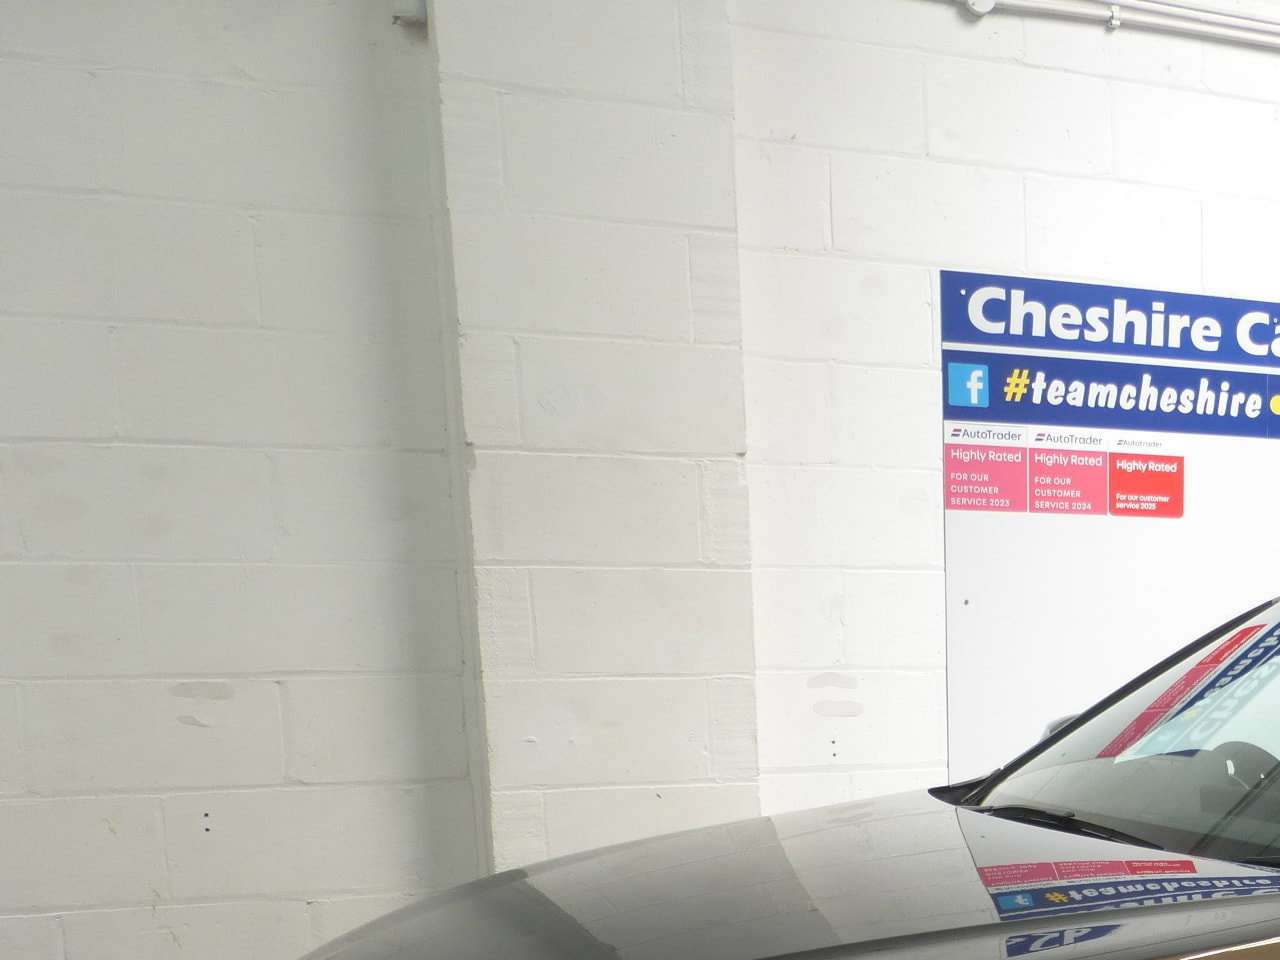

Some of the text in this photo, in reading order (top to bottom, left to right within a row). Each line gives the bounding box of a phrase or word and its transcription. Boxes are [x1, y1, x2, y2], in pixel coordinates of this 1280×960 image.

[968, 286, 1222, 353] Cheshire
[1003, 368, 1262, 419] #teamcheshire
[962, 428, 1022, 441] AutoTrader
[1046, 433, 1103, 446] AutoTrader
[951, 448, 1022, 463] Highly Rated
[1034, 453, 1103, 467] Highly Rated
[1116, 459, 1178, 473] Highly Rated
[950, 472, 989, 482] FOR OUR
[1034, 476, 1072, 485] FOR OUR
[950, 485, 999, 494] CUSTOMER
[1034, 489, 1081, 498] CUSTOMER
[951, 497, 987, 506] SERVICE
[1034, 501, 1069, 510] SERVICE
